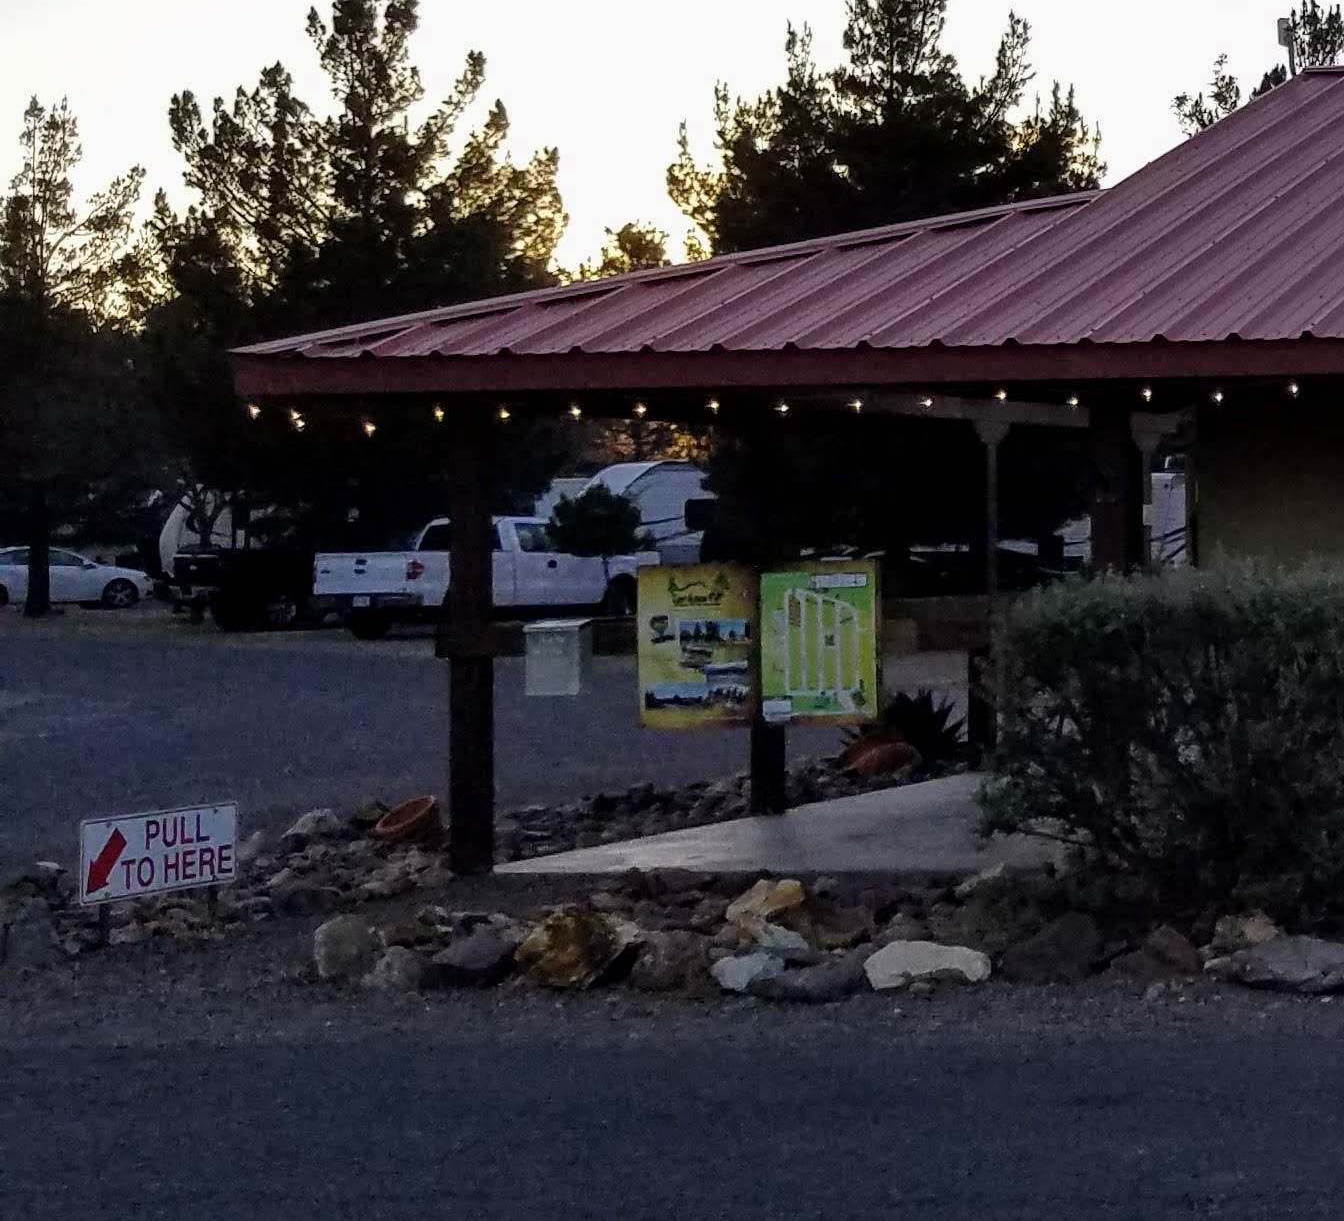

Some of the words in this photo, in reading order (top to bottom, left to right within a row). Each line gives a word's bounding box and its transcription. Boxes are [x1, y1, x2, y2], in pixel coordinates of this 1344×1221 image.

[145, 814, 210, 851] PULL
[120, 856, 155, 890] TO
[163, 844, 233, 884] HERE
